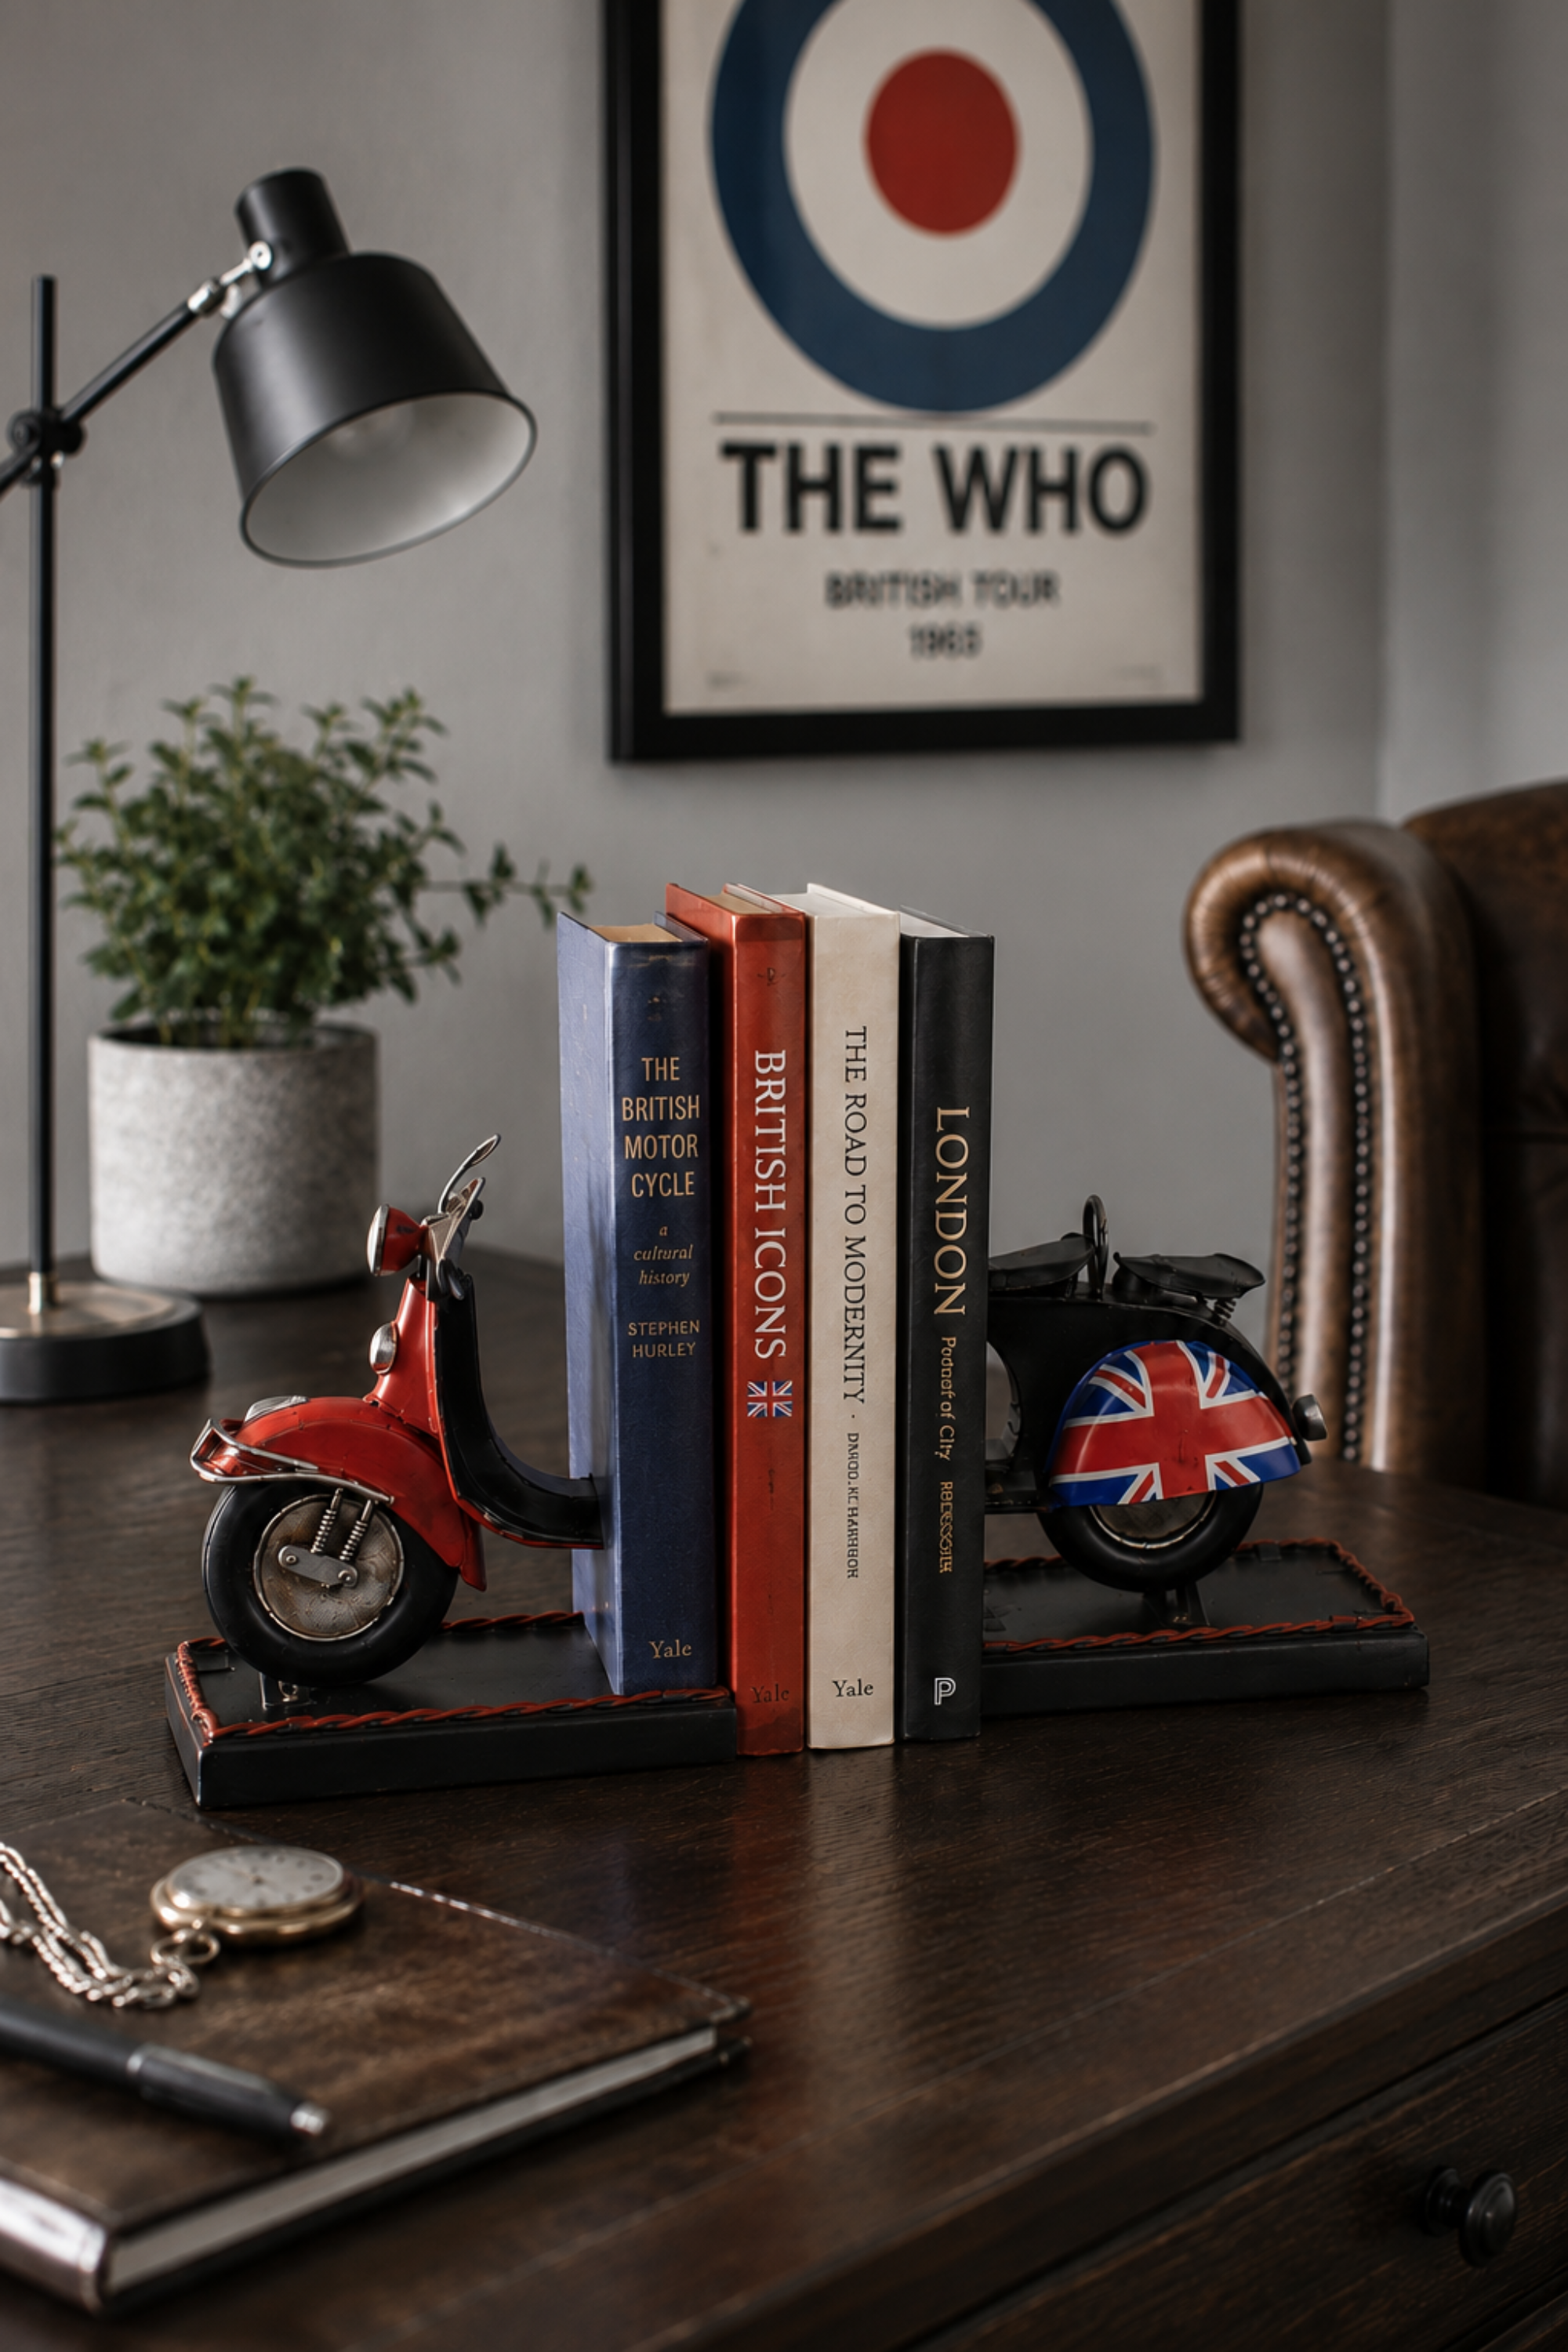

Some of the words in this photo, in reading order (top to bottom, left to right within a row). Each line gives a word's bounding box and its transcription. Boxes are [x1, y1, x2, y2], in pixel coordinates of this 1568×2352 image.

[719, 441, 902, 535] THE
[933, 441, 1152, 537] WHO
[825, 569, 962, 608] BRITISH
[971, 569, 1059, 608] TOUR
[844, 1025, 867, 1083] THE
[641, 1056, 681, 1082] THE
[622, 1094, 701, 1122] BRITISH
[753, 1050, 786, 1213] BRITISH
[844, 1093, 867, 1178] ROAD
[624, 1134, 699, 1160] MOTOR
[631, 1171, 695, 1198] CYCLE
[844, 1184, 866, 1225] TO
[933, 1106, 971, 1316] LONDON
[659, 1225, 669, 1237] a
[633, 1244, 693, 1261] cultural
[639, 1270, 690, 1287] history
[753, 1227, 786, 1360] ICONS
[628, 1320, 701, 1337] STEPHEN
[843, 1236, 866, 1403] MODERNITY
[632, 1342, 696, 1359] HURLEY
[940, 1402, 956, 1420] of
[649, 1639, 692, 1659] Yale
[751, 1682, 789, 1704] Yale
[833, 1678, 873, 1698] Yale
[933, 1677, 956, 1706] P
